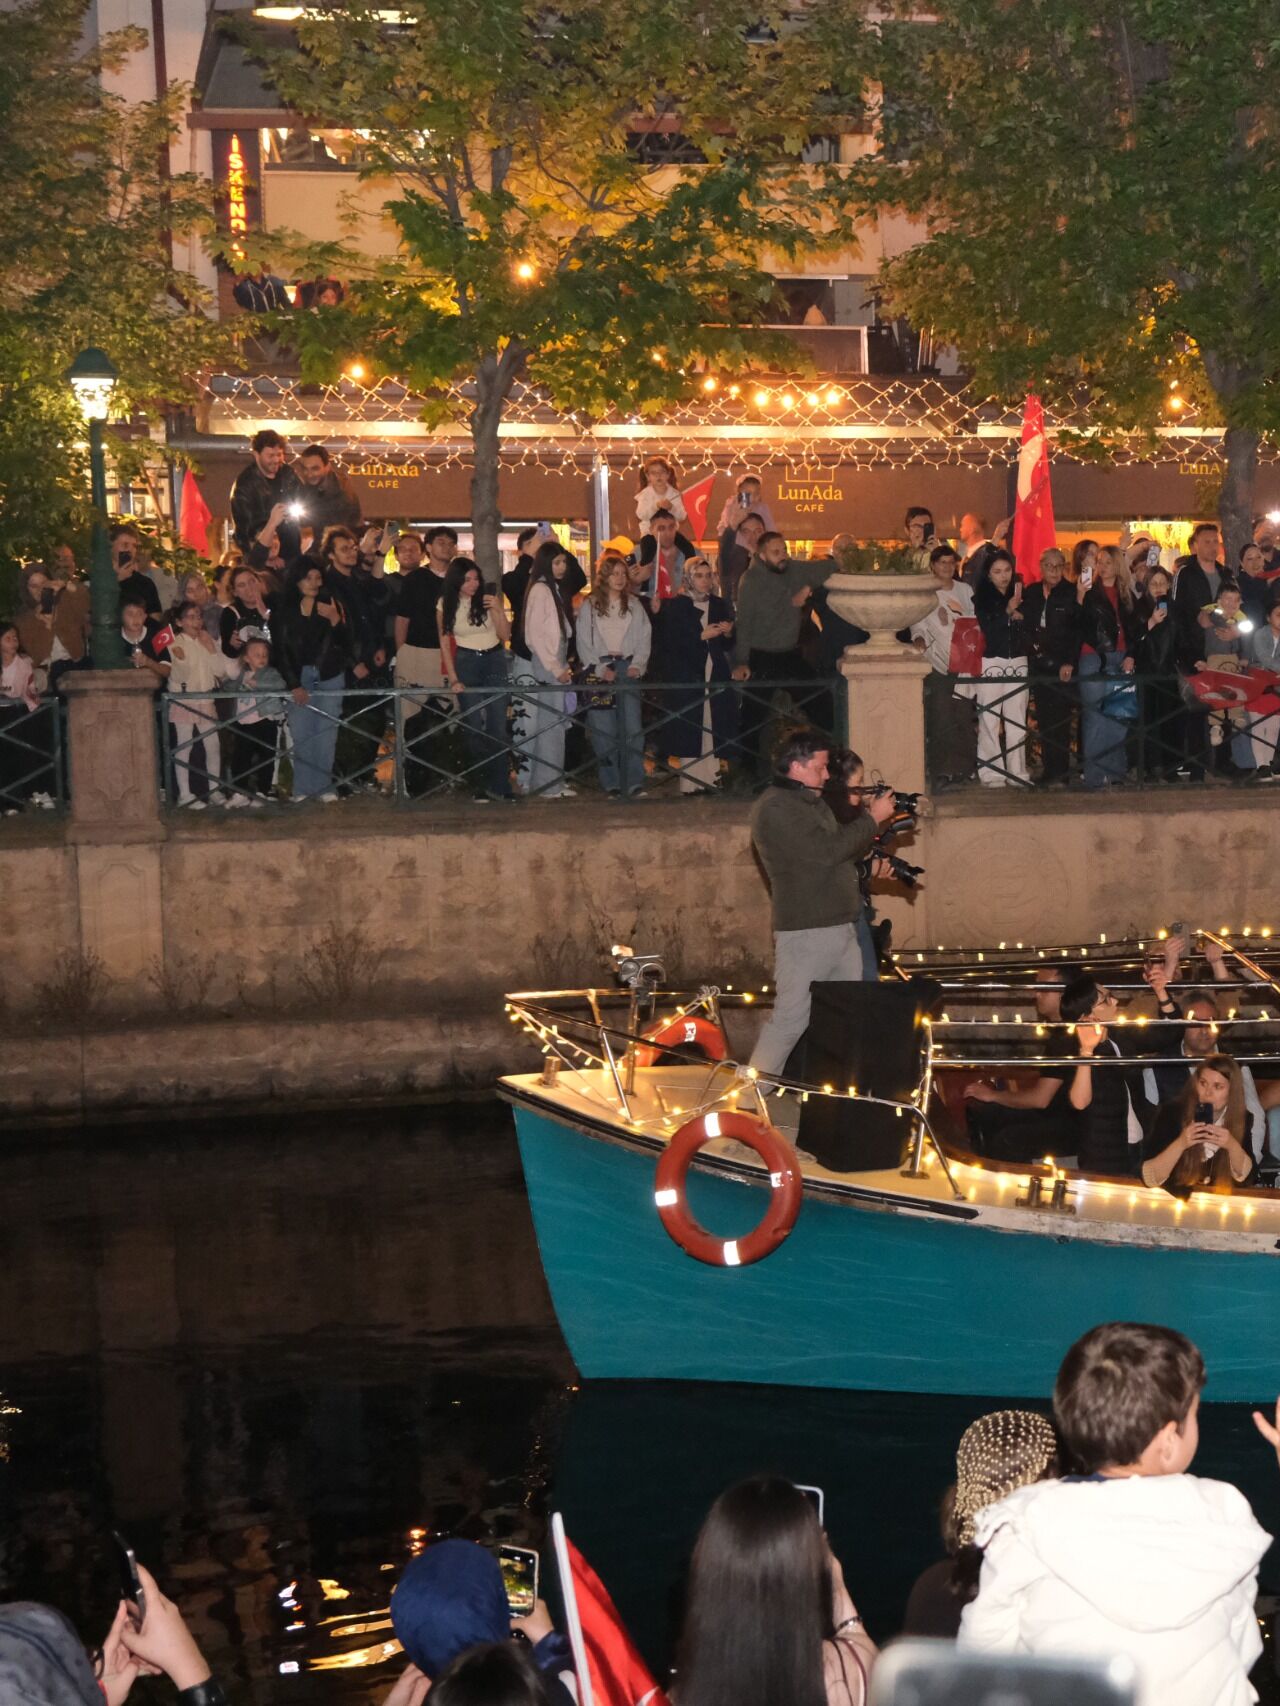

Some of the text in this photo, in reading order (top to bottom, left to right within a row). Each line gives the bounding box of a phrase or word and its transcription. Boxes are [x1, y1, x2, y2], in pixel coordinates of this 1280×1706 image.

[348, 463, 419, 477] LunAda
[1179, 462, 1226, 475] LunA
[777, 484, 844, 501] LunAda
